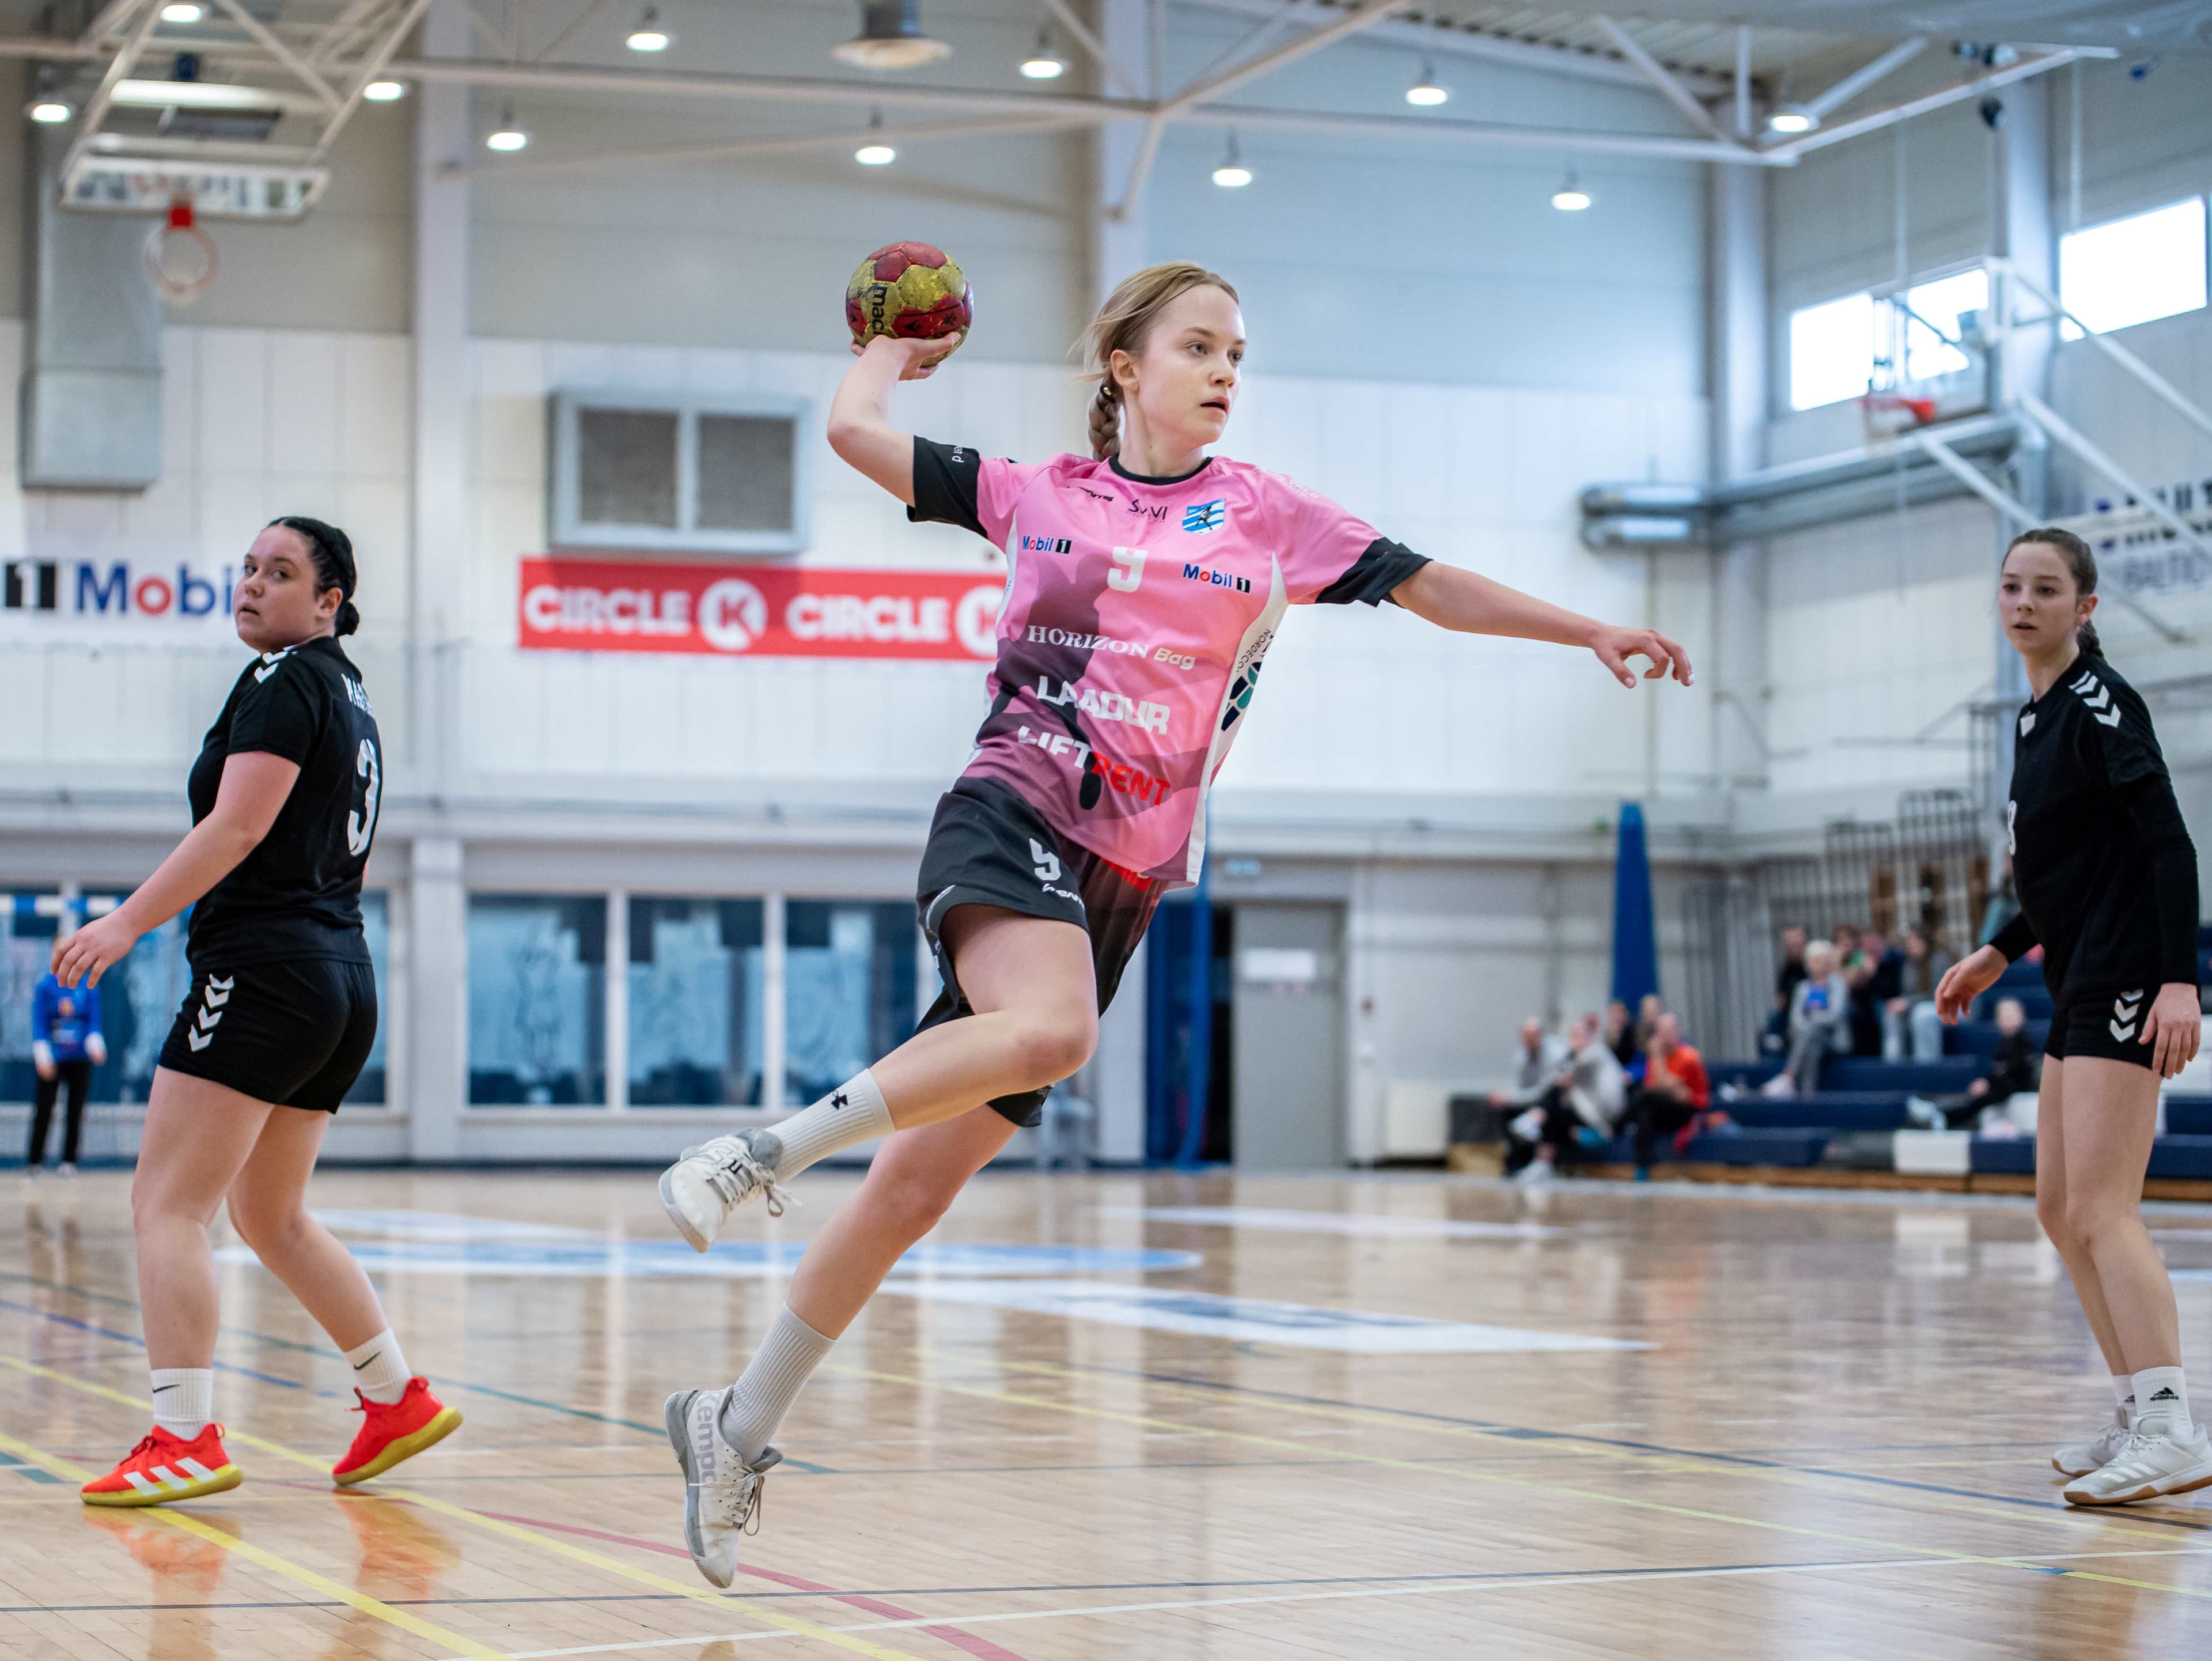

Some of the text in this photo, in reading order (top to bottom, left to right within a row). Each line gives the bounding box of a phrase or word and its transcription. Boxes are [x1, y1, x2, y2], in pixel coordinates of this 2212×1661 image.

[1022, 536, 1054, 553] Mobil
[77, 562, 235, 615] Mobi
[1183, 563, 1232, 588] Mobil
[525, 585, 692, 636] CIRCLE
[786, 593, 949, 642] CIRCLE
[1027, 625, 1196, 670] HORIZON Bag
[1037, 675, 1171, 735] LAADUR
[347, 739, 379, 857] 3
